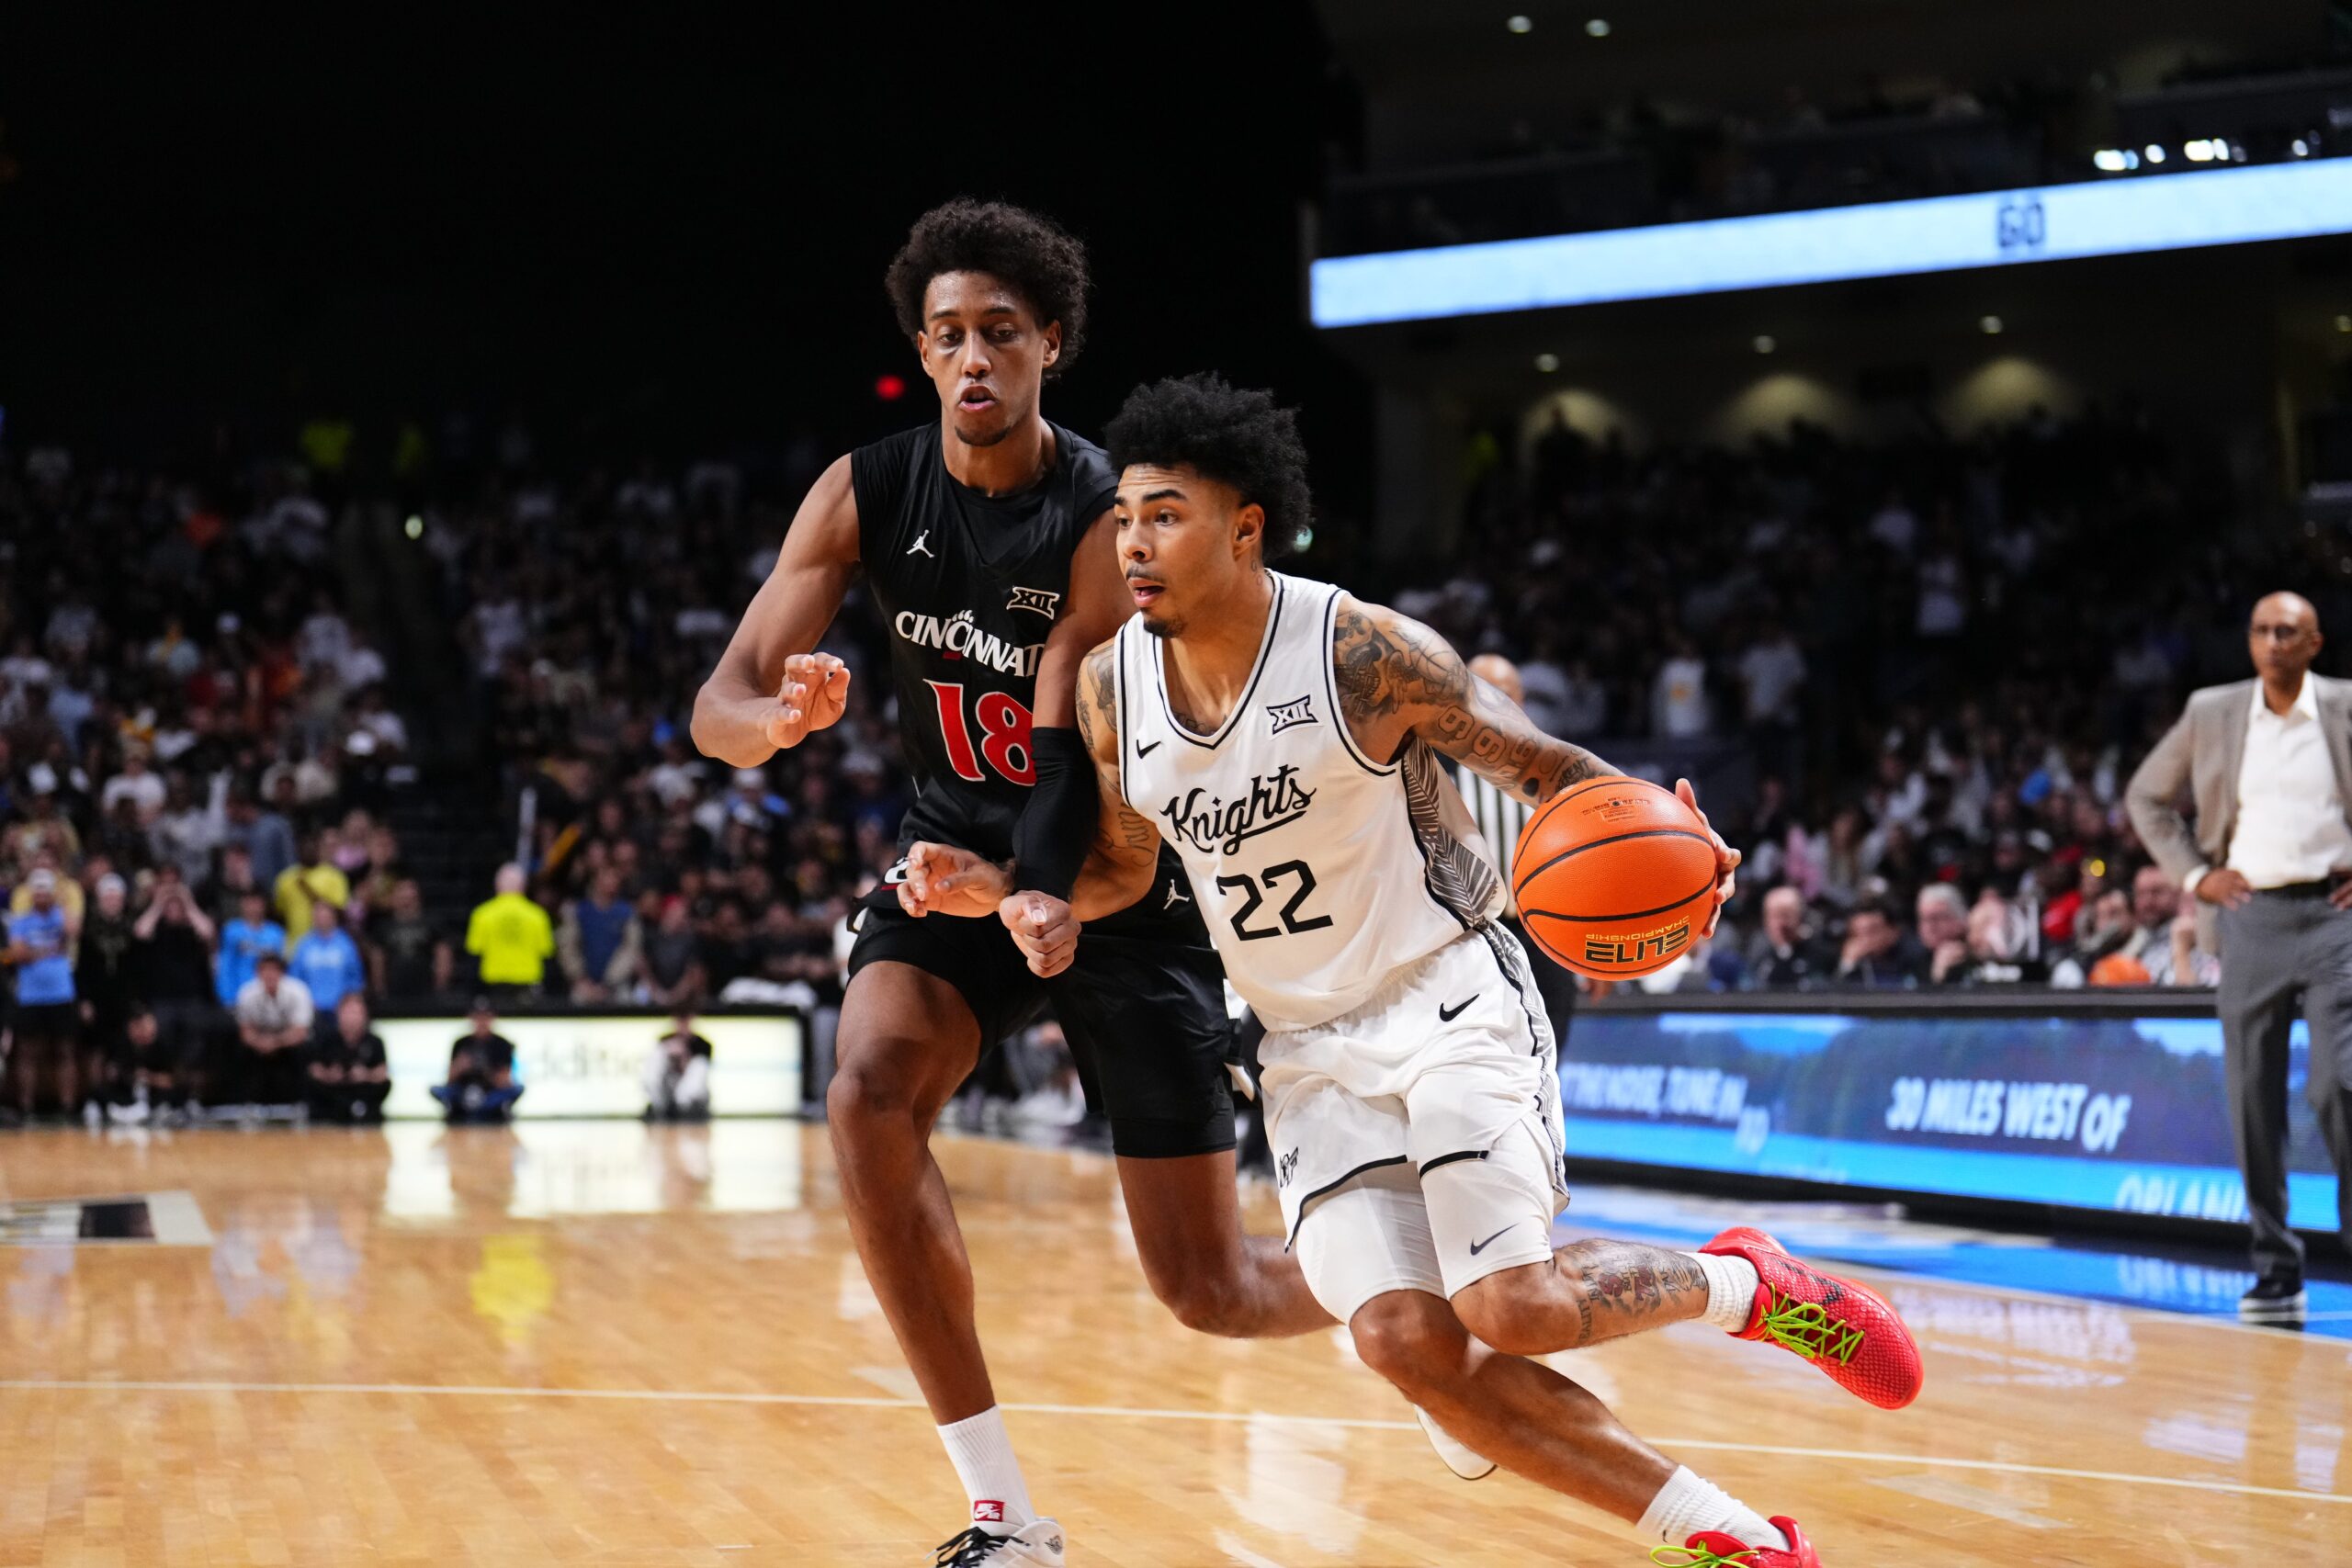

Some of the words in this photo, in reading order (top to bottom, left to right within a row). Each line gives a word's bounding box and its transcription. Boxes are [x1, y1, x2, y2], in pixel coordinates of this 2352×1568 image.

[895, 610, 1046, 678] CINCINNAT
[922, 678, 1037, 786] 18
[1159, 763, 1317, 856] Knights
[1216, 859, 1334, 942] 22
[1585, 915, 1690, 942] CHAMPIONSHIP
[1584, 922, 1690, 964] ELITE
[1921, 1078, 2006, 1136] MILES
[2005, 1081, 2088, 1140] WEST
[2081, 1093, 2132, 1154] OF
